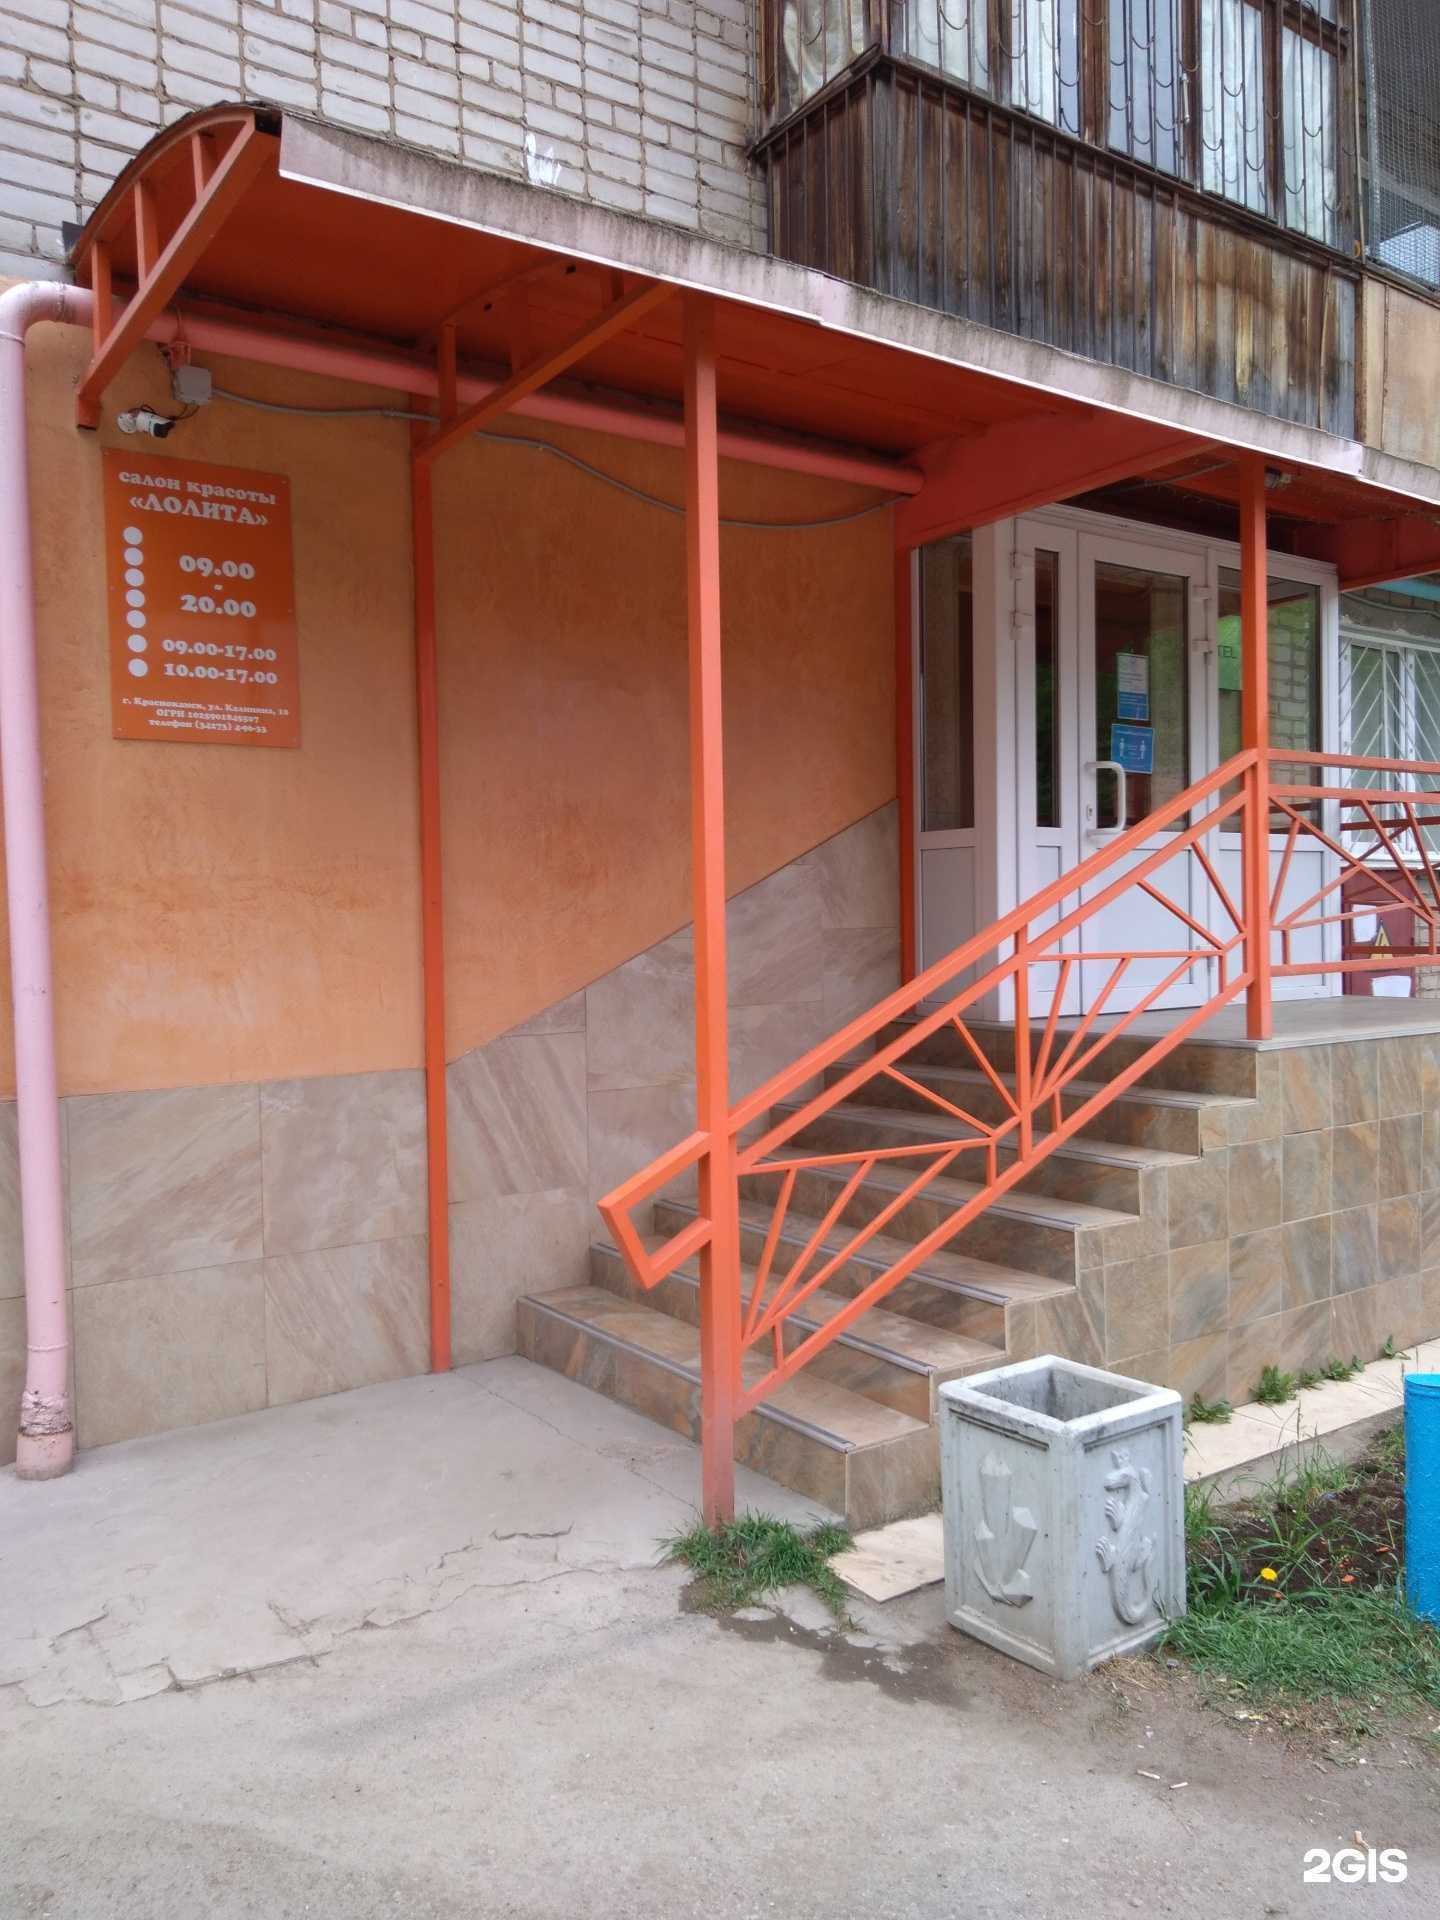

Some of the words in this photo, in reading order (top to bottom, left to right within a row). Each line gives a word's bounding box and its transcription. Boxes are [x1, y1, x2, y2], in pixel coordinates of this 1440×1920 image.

[118, 471, 180, 490] салон
[187, 481, 276, 504] красоты
[179, 555, 255, 580] 09.00
[180, 594, 256, 618] 20.00
[162, 639, 277, 661] 09.00-17.00
[164, 663, 277, 684] 10.00-17.00
